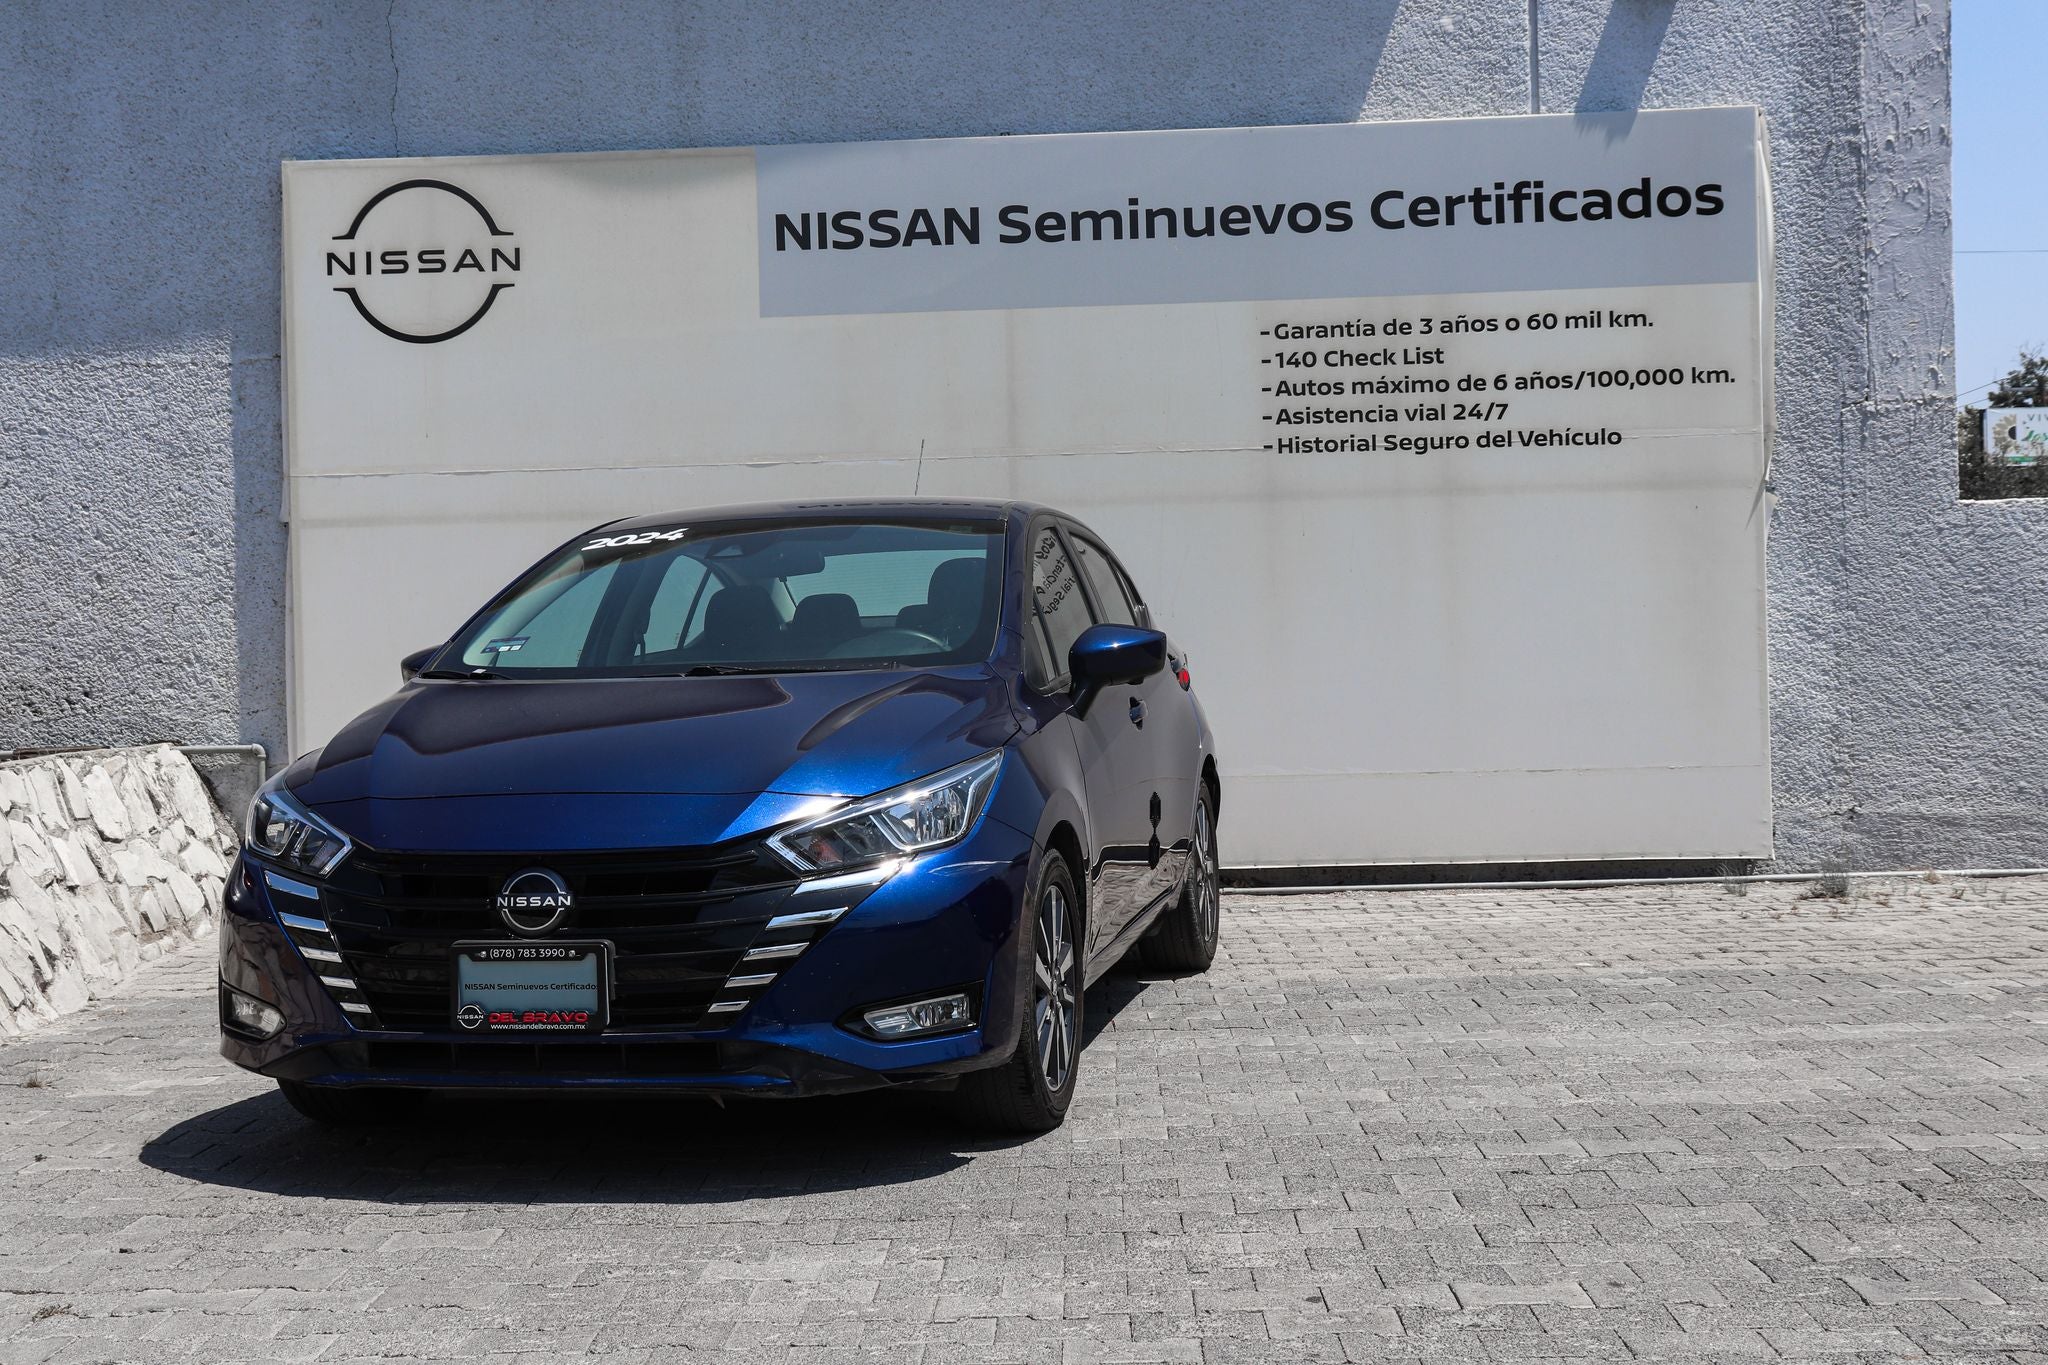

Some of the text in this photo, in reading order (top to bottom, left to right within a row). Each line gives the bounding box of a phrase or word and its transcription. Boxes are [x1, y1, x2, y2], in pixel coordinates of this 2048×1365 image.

[776, 176, 1725, 251] NISSAN Seminuevos Certificados
[326, 247, 521, 276] NISSAN
[1382, 318, 1413, 336] de
[1419, 317, 1433, 335] 3
[1439, 314, 1499, 334] años
[1504, 317, 1521, 332] o
[1526, 312, 1558, 331] 60
[1564, 310, 1602, 330] mil
[1609, 310, 1654, 328] km.
[1323, 347, 1397, 368] Check
[1403, 346, 1445, 365] List
[1351, 375, 1450, 395] máximo
[1456, 373, 1487, 392] de
[1493, 373, 1508, 391] 6
[1514, 367, 1685, 391] años/100,000
[1691, 366, 1736, 384] km.
[1403, 403, 1446, 422] vial
[1452, 401, 1509, 422] 24/7
[1383, 434, 1470, 456] Seguro
[1475, 429, 1513, 449] del
[1517, 427, 1623, 447] Vehículo
[581, 527, 689, 551] 2024
[497, 895, 571, 907] NISSAN
[489, 948, 566, 959] (878) 783 3990
[497, 982, 549, 990] Seminuevos
[550, 982, 598, 990] Certificado
[488, 1011, 589, 1023] DEL BRAVO
[490, 1023, 586, 1031] www.nissandelbravo.com.mx
